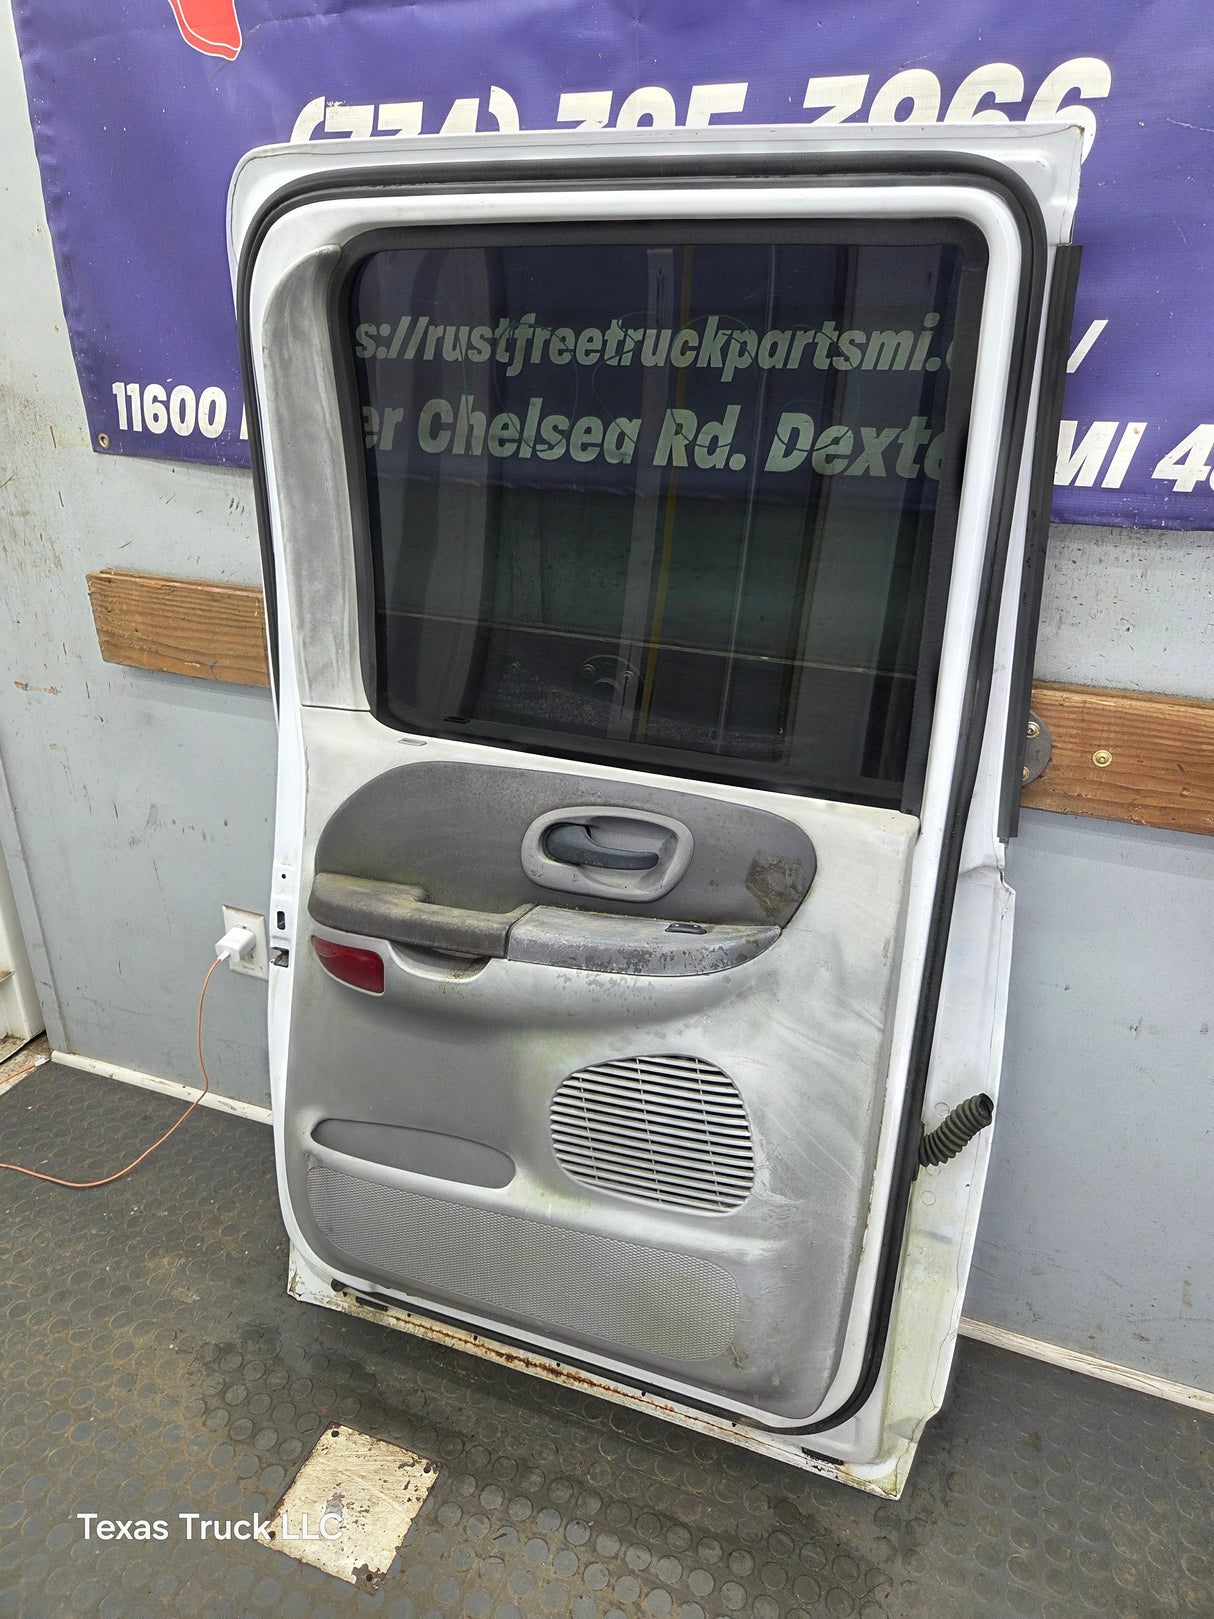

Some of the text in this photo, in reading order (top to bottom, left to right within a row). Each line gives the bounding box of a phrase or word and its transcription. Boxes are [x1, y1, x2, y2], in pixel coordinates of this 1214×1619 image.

[355, 312, 953, 382] s://rustfreetruckpartsmi.
[111, 381, 228, 439] 11600
[417, 395, 642, 464] Chelsea
[653, 405, 747, 471] Rd.
[1053, 420, 1148, 489] MI
[1151, 424, 1214, 493] 4
